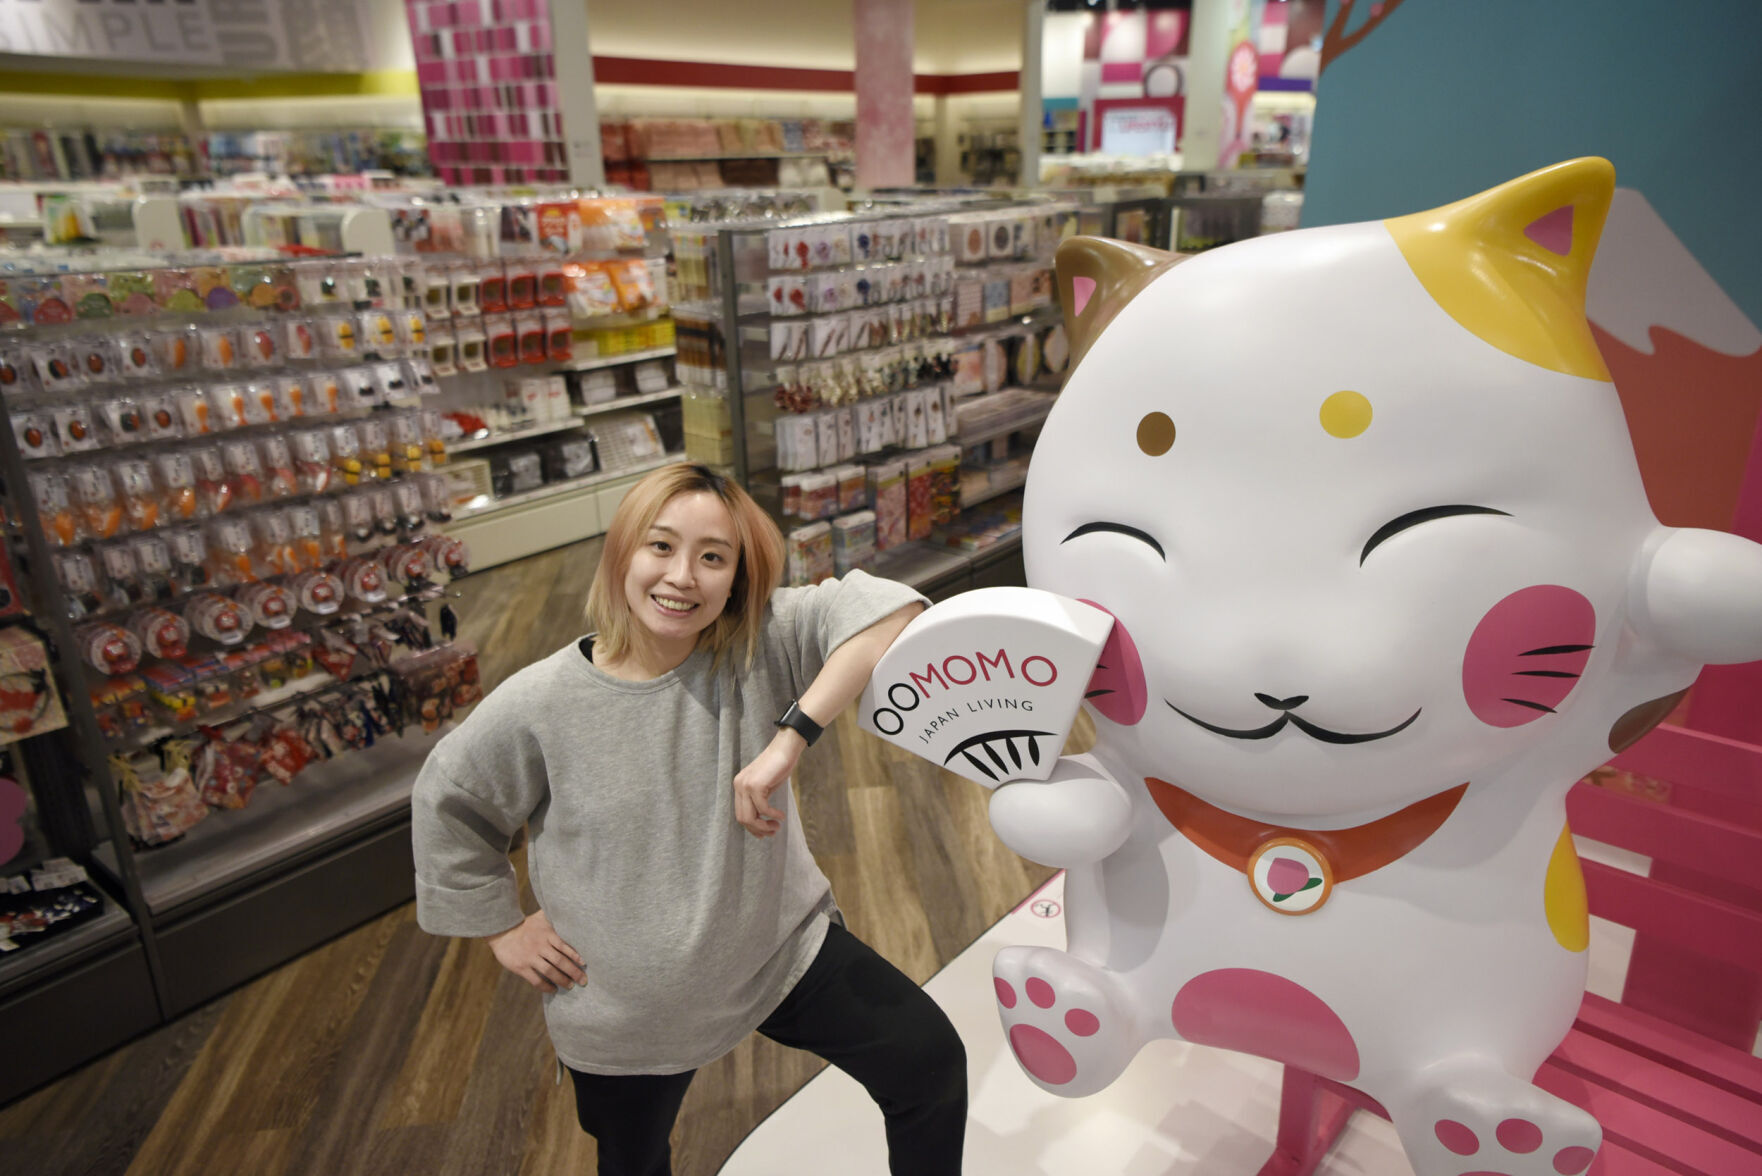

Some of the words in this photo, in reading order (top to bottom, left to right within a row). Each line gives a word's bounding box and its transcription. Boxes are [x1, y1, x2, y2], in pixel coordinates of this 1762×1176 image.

[873, 649, 1057, 735] OOMOMO
[919, 708, 959, 744] JAPAN
[967, 698, 1033, 713] LIVING
